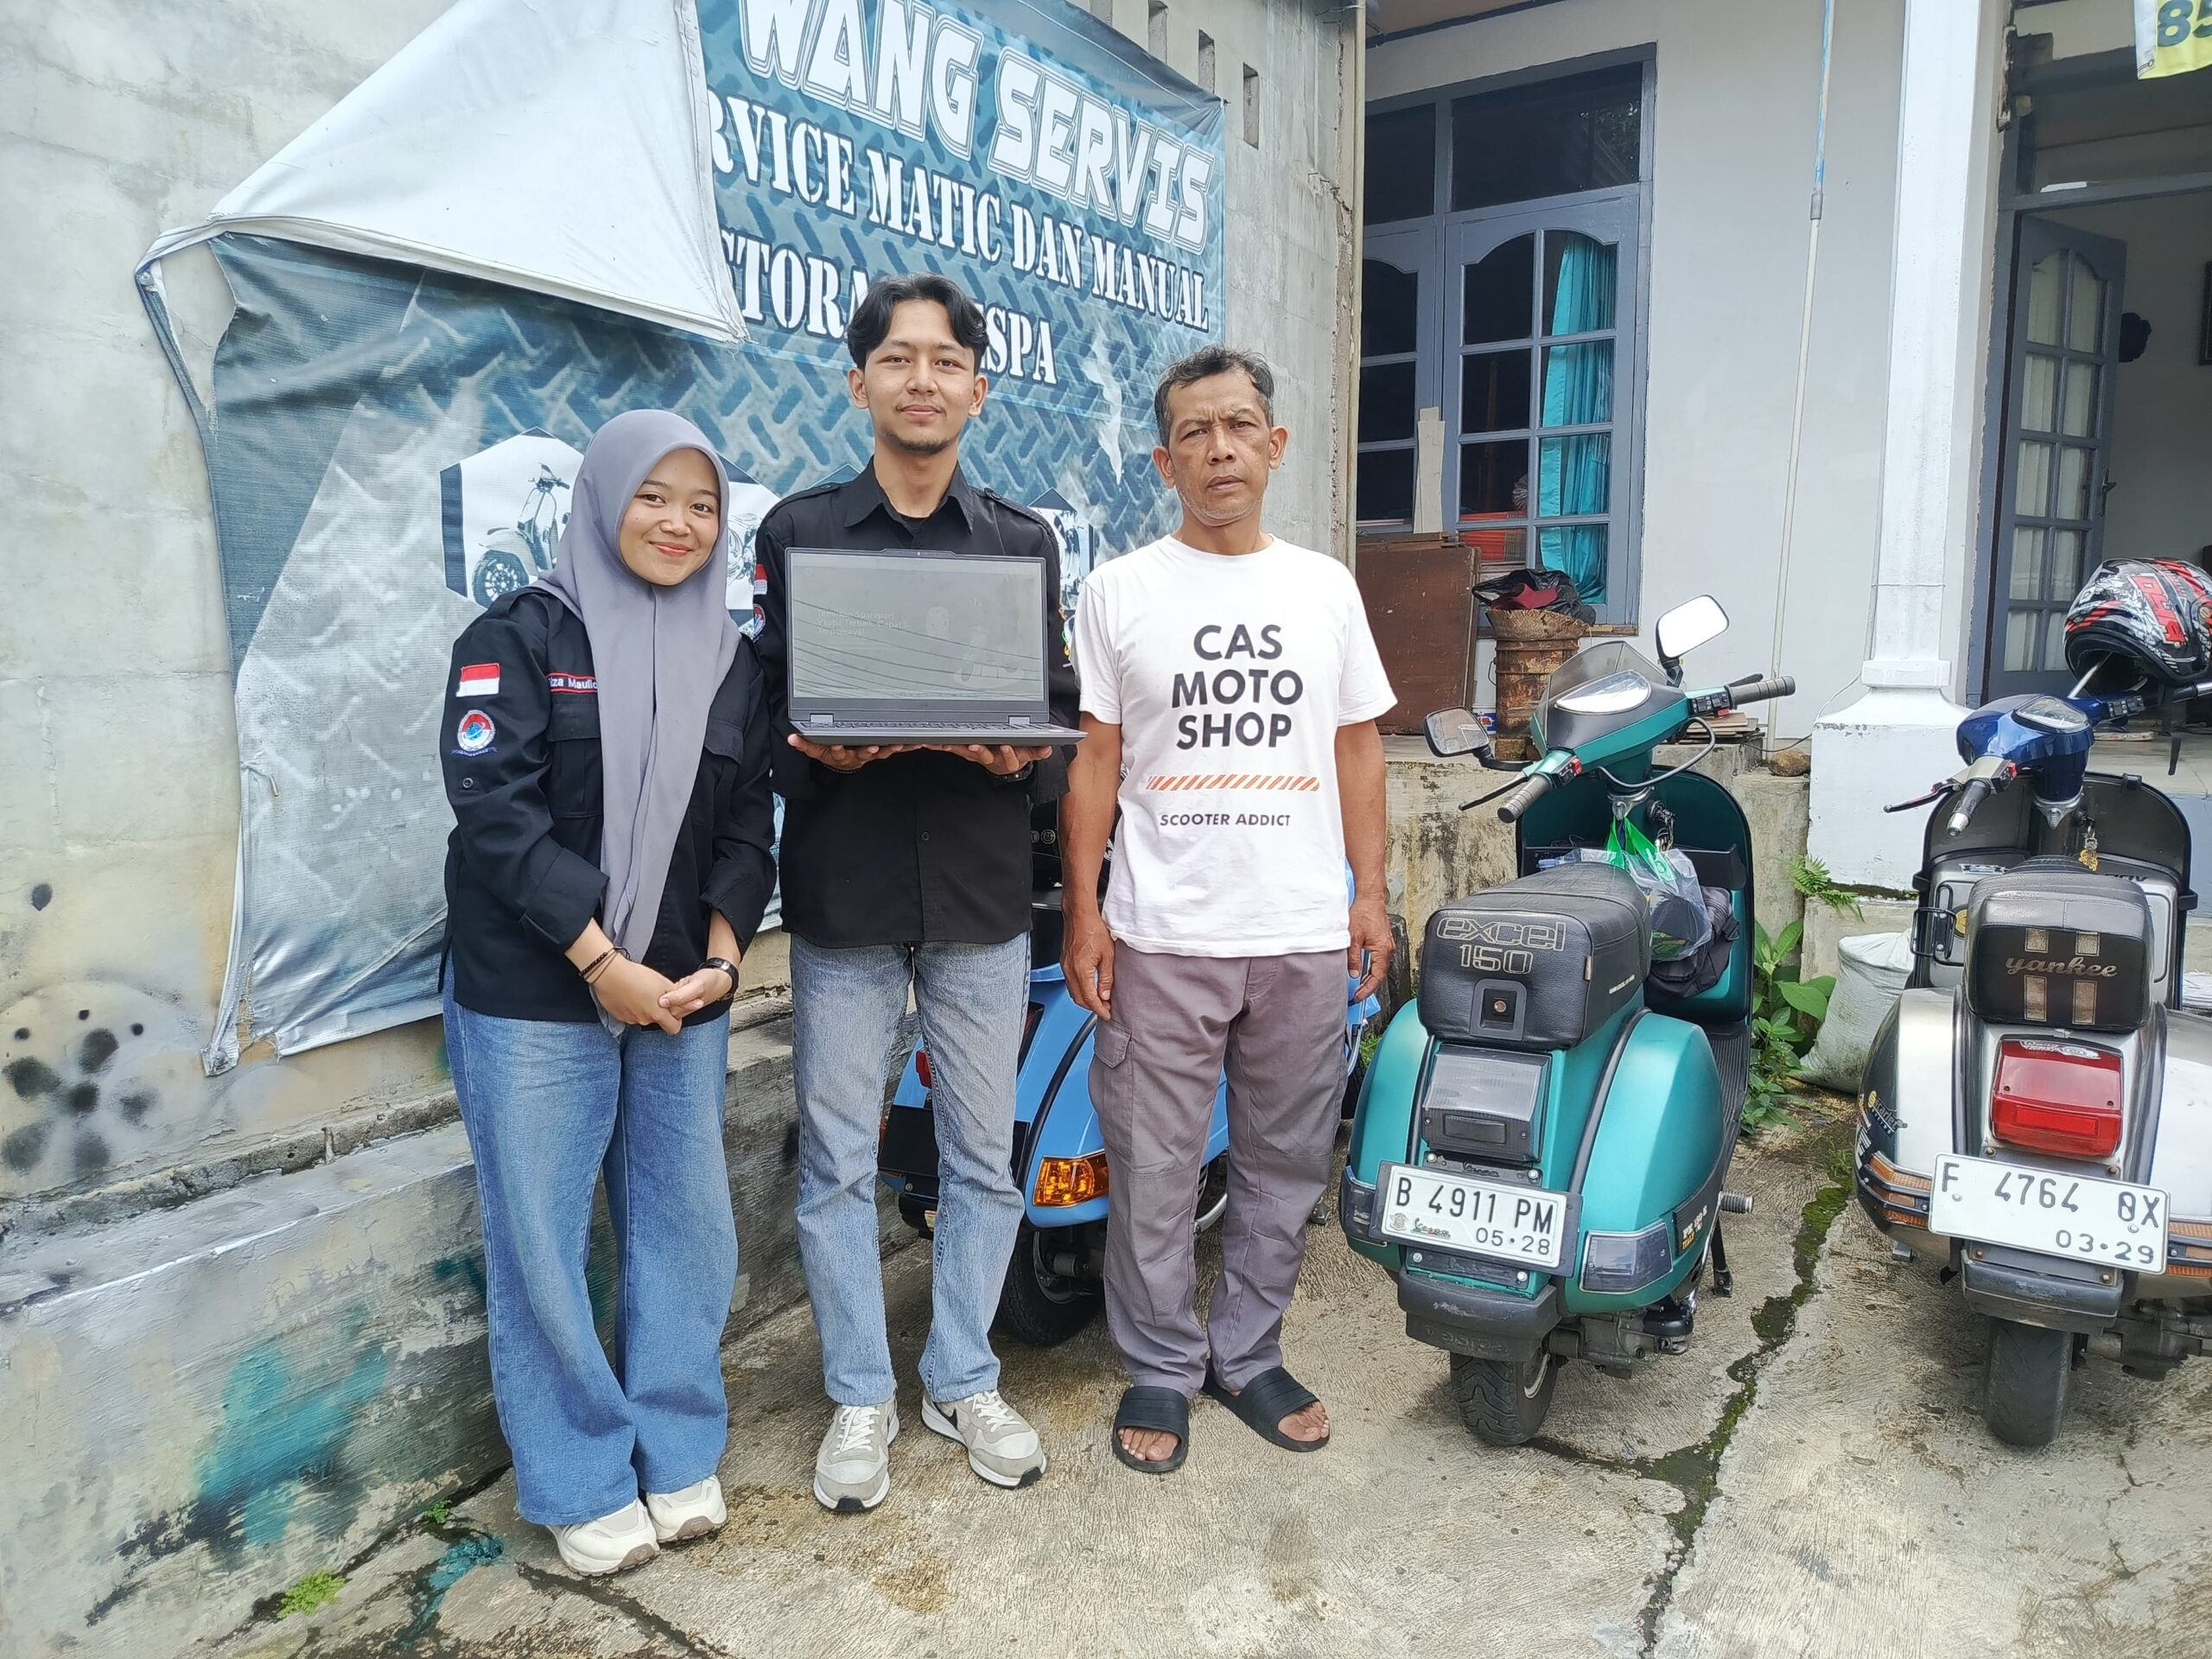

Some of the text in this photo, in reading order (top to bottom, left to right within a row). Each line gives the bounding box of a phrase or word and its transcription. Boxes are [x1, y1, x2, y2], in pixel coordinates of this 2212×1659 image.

[739, 0, 1215, 255] WANG SERVIS
[866, 148, 1002, 262] MATIC
[1010, 204, 1083, 289] DAN
[1090, 234, 1209, 333] MANUAL
[975, 302, 1057, 385] SPA
[1193, 624, 1283, 661] CAS
[1172, 669, 1304, 709] MOTO
[1176, 711, 1292, 750] SHOP
[1160, 813, 1291, 827] SCOOTER ADDICT
[1437, 917, 1567, 951] excel
[1459, 944, 1534, 975] 150
[2005, 957, 2118, 977] yankee
[1395, 1177, 1554, 1234] B 4911 PM
[1942, 1162, 1960, 1192] F
[1994, 1172, 2079, 1212] 4764
